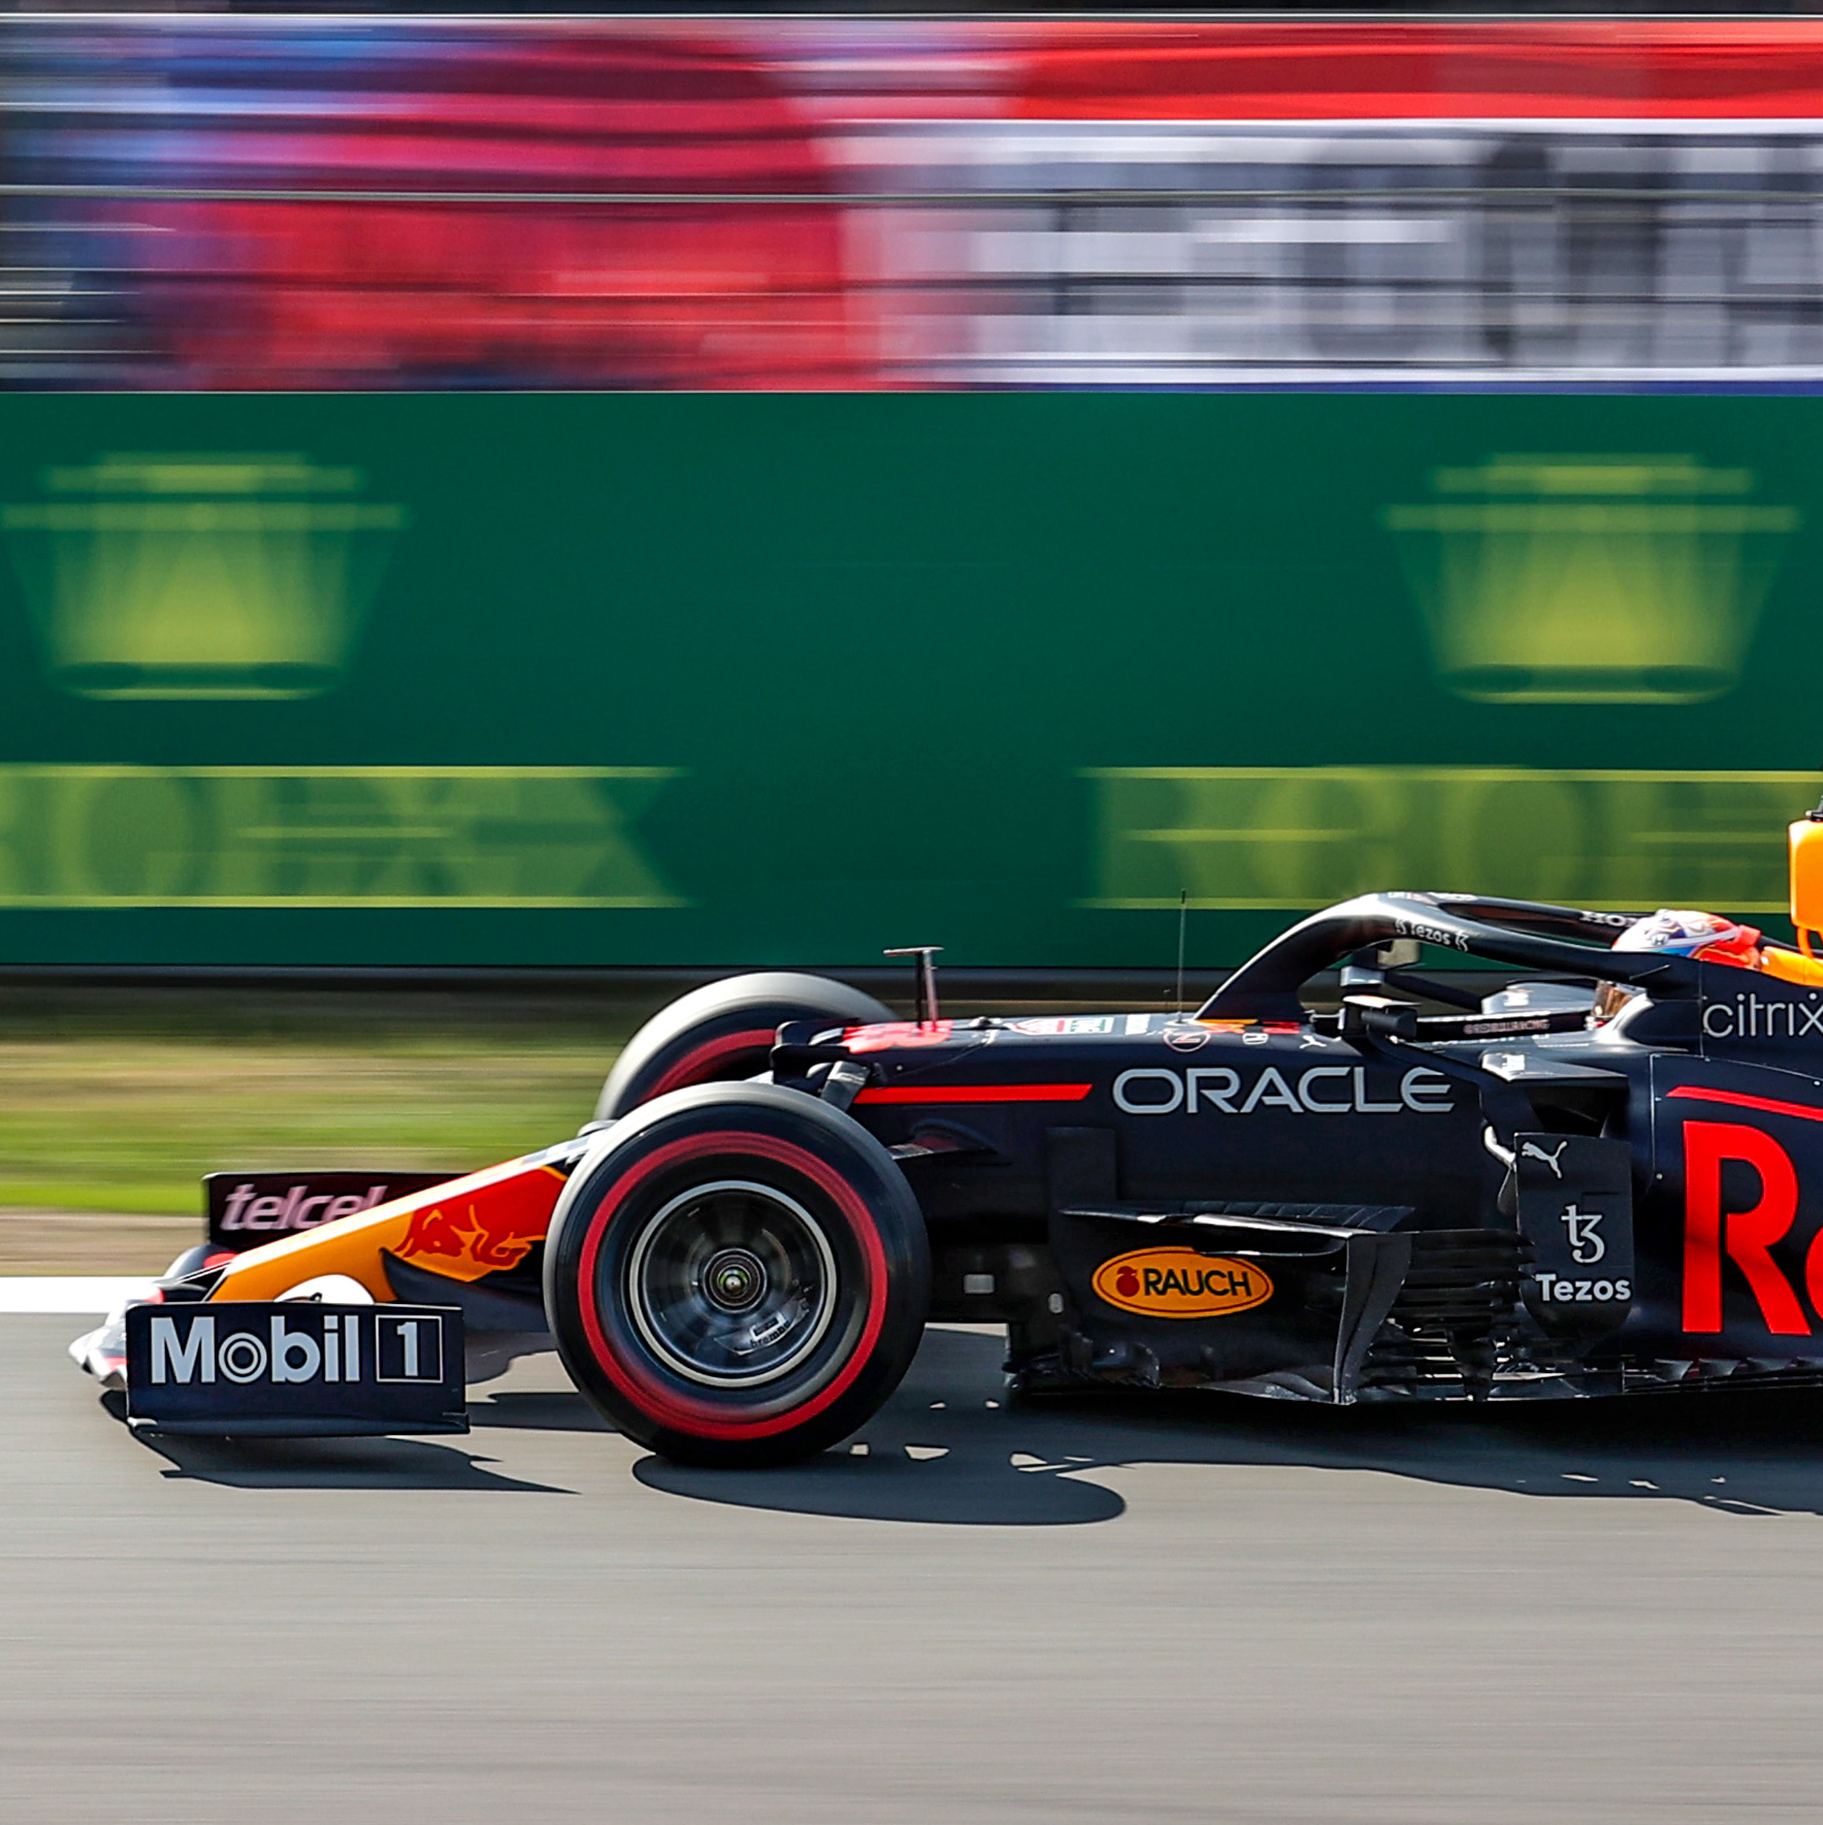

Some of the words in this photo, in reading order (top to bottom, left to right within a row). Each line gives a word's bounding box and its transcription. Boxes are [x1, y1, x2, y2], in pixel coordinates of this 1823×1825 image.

[1111, 1066, 1456, 1115] ORACLE
[1143, 1268, 1253, 1297] RAUCH
[1534, 1273, 1632, 1302] Tezos
[149, 1314, 361, 1385] Mobil
[396, 1321, 420, 1377] 1
